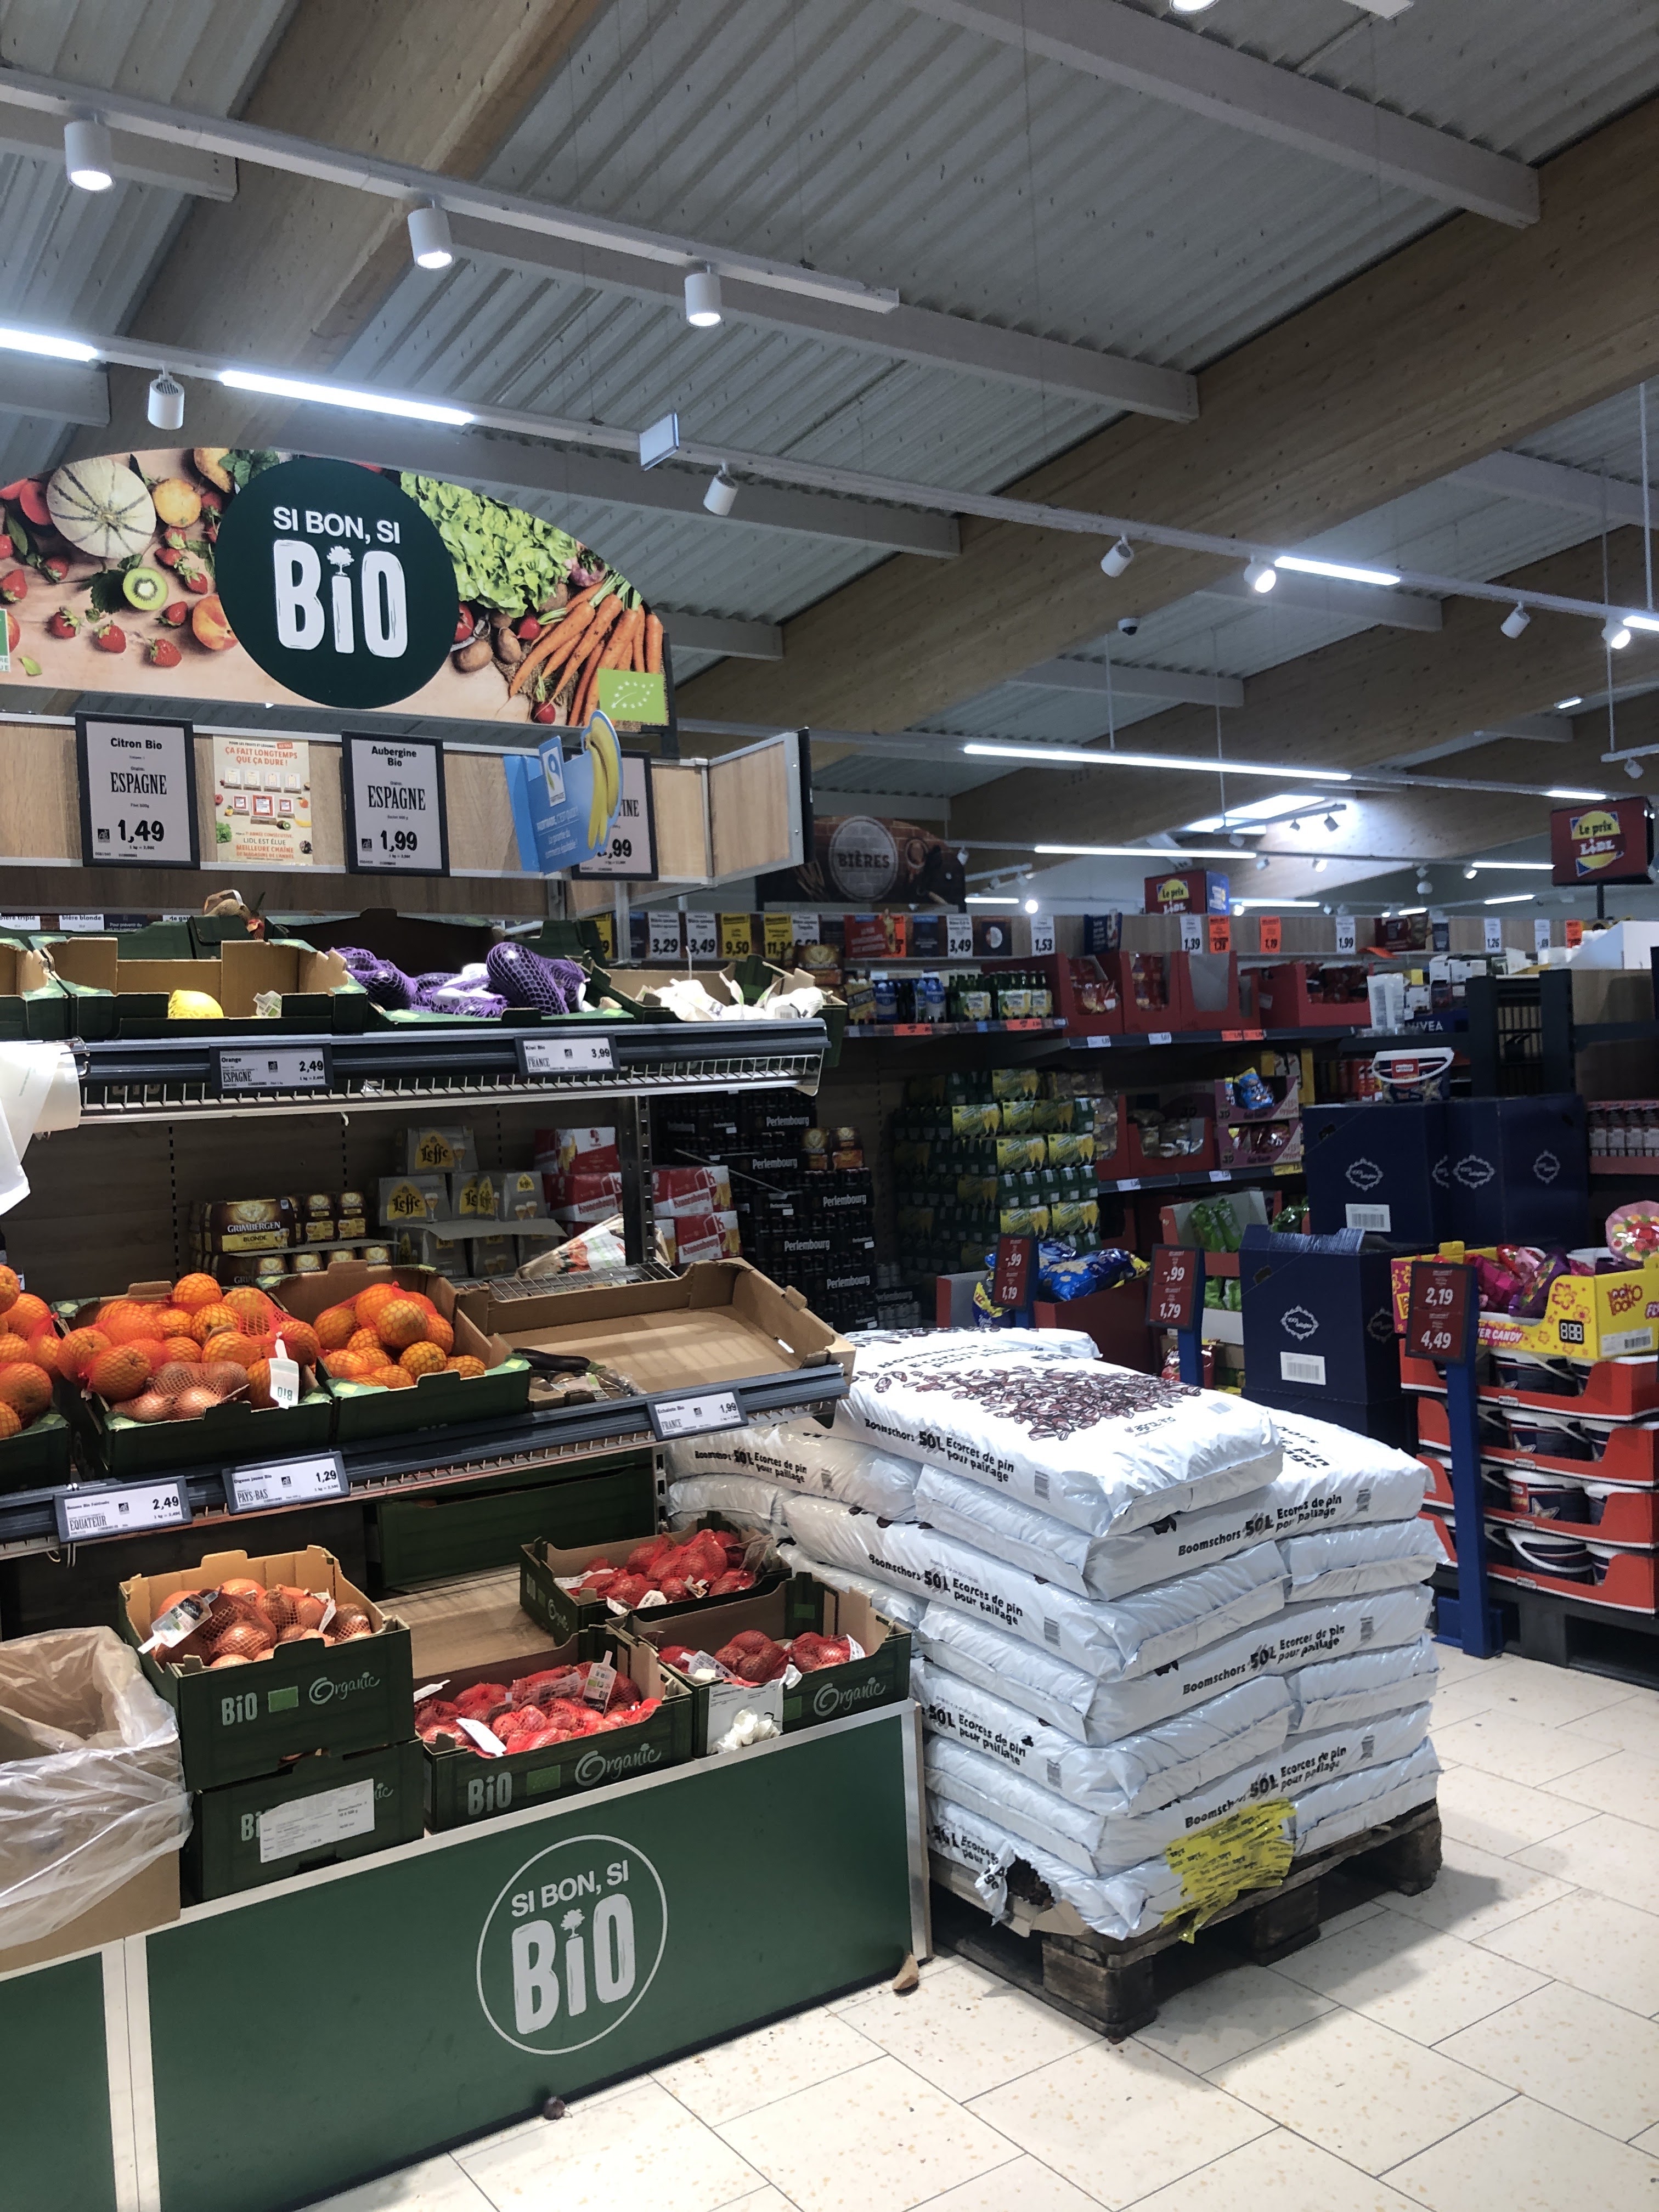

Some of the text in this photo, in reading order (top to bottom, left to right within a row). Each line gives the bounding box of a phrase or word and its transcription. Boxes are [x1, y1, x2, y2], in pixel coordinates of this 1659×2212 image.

[273, 506, 400, 544] SI BON, SI
[110, 738, 162, 750] Citron Bio
[225, 747, 235, 755] ÇA
[255, 749, 298, 759] LONGTEMPS
[371, 746, 417, 758] Aubergine
[236, 755, 251, 764] QUE
[253, 757, 263, 765] ÇA
[264, 758, 284, 766] DURE
[388, 758, 402, 766] Bio
[110, 772, 167, 795] ESPAGNE
[368, 785, 426, 810] ESPAGNE
[117, 819, 164, 843] 1,49
[1579, 820, 1612, 836] Le prix
[271, 837, 286, 845] ÉLUE
[380, 830, 417, 852] 1,99
[597, 838, 631, 859] ,99
[838, 850, 890, 868] BIÈRES
[1163, 887, 1184, 899] Le prix
[652, 938, 678, 955] 3,29
[690, 938, 715, 955] 3,49
[725, 941, 749, 956] 9,50
[950, 939, 971, 954] 3,49
[1035, 938, 1052, 952] 1,53
[1184, 938, 1200, 952] 1,39
[1339, 936, 1353, 949] 1,99
[591, 1048, 610, 1059] 3,99
[299, 1060, 324, 1073] 2,49
[528, 1058, 550, 1068] FRANCE
[223, 1071, 252, 1083] ESPAGNE
[766, 1116, 809, 1127] Perlembourg
[420, 1143, 448, 1165] Leffe
[752, 1157, 798, 1170] Perlembourg
[393, 1193, 421, 1215] Leffe
[823, 1194, 866, 1207] Perlembourg
[227, 1221, 281, 1233] GRIMBERGEN
[784, 1239, 830, 1252] Perlembourg
[1163, 1266, 1184, 1283] -,99
[827, 1276, 870, 1289] Perlembourg
[1002, 1285, 1018, 1300] 1,19
[1425, 1286, 1454, 1306] 2,19
[1160, 1302, 1181, 1319] 1,79
[1420, 1330, 1452, 1350] 4,49
[1492, 1331, 1523, 1342] CANDY
[720, 1402, 737, 1414] 1,99
[661, 1419, 682, 1431] FRANCE
[946, 1437, 979, 1459] Ecorces
[983, 1452, 995, 1465] de
[998, 1459, 1014, 1473] pin
[947, 1449, 968, 1464] pour
[754, 1452, 782, 1467] Ecorces
[784, 1459, 793, 1470] de
[795, 1463, 807, 1476] pin
[756, 1464, 772, 1474] pour
[316, 1470, 337, 1483] 1,29
[153, 1496, 179, 1510] 2,49
[238, 1488, 269, 1503] PAYS-BAS
[69, 1515, 107, 1531] EQUATEUR
[1178, 1529, 1241, 1556] Boomschors
[1312, 1497, 1325, 1508] de
[1325, 1494, 1342, 1509] pin
[952, 1578, 989, 1601] Ecorces
[991, 1595, 1003, 1607] de
[1007, 1602, 1023, 1617] pin
[954, 1591, 977, 1606] pour
[1183, 1664, 1246, 1695] Boomschors
[1280, 1632, 1312, 1650] Ecorces
[1329, 1625, 1345, 1640] pin
[1277, 1649, 1300, 1664] pour
[309, 1672, 380, 1705] Organic
[813, 1677, 886, 1717] Organic
[958, 1713, 992, 1738] Ecorces
[995, 1733, 1007, 1747] de
[1009, 1741, 1026, 1757] pin
[959, 1728, 981, 1743] pour
[575, 1743, 662, 1787] Organic
[1280, 1757, 1316, 1778] Ecorces
[1331, 1746, 1347, 1762] pin
[1280, 1775, 1304, 1792] pour
[511, 1860, 629, 1917] SI BON, SI
